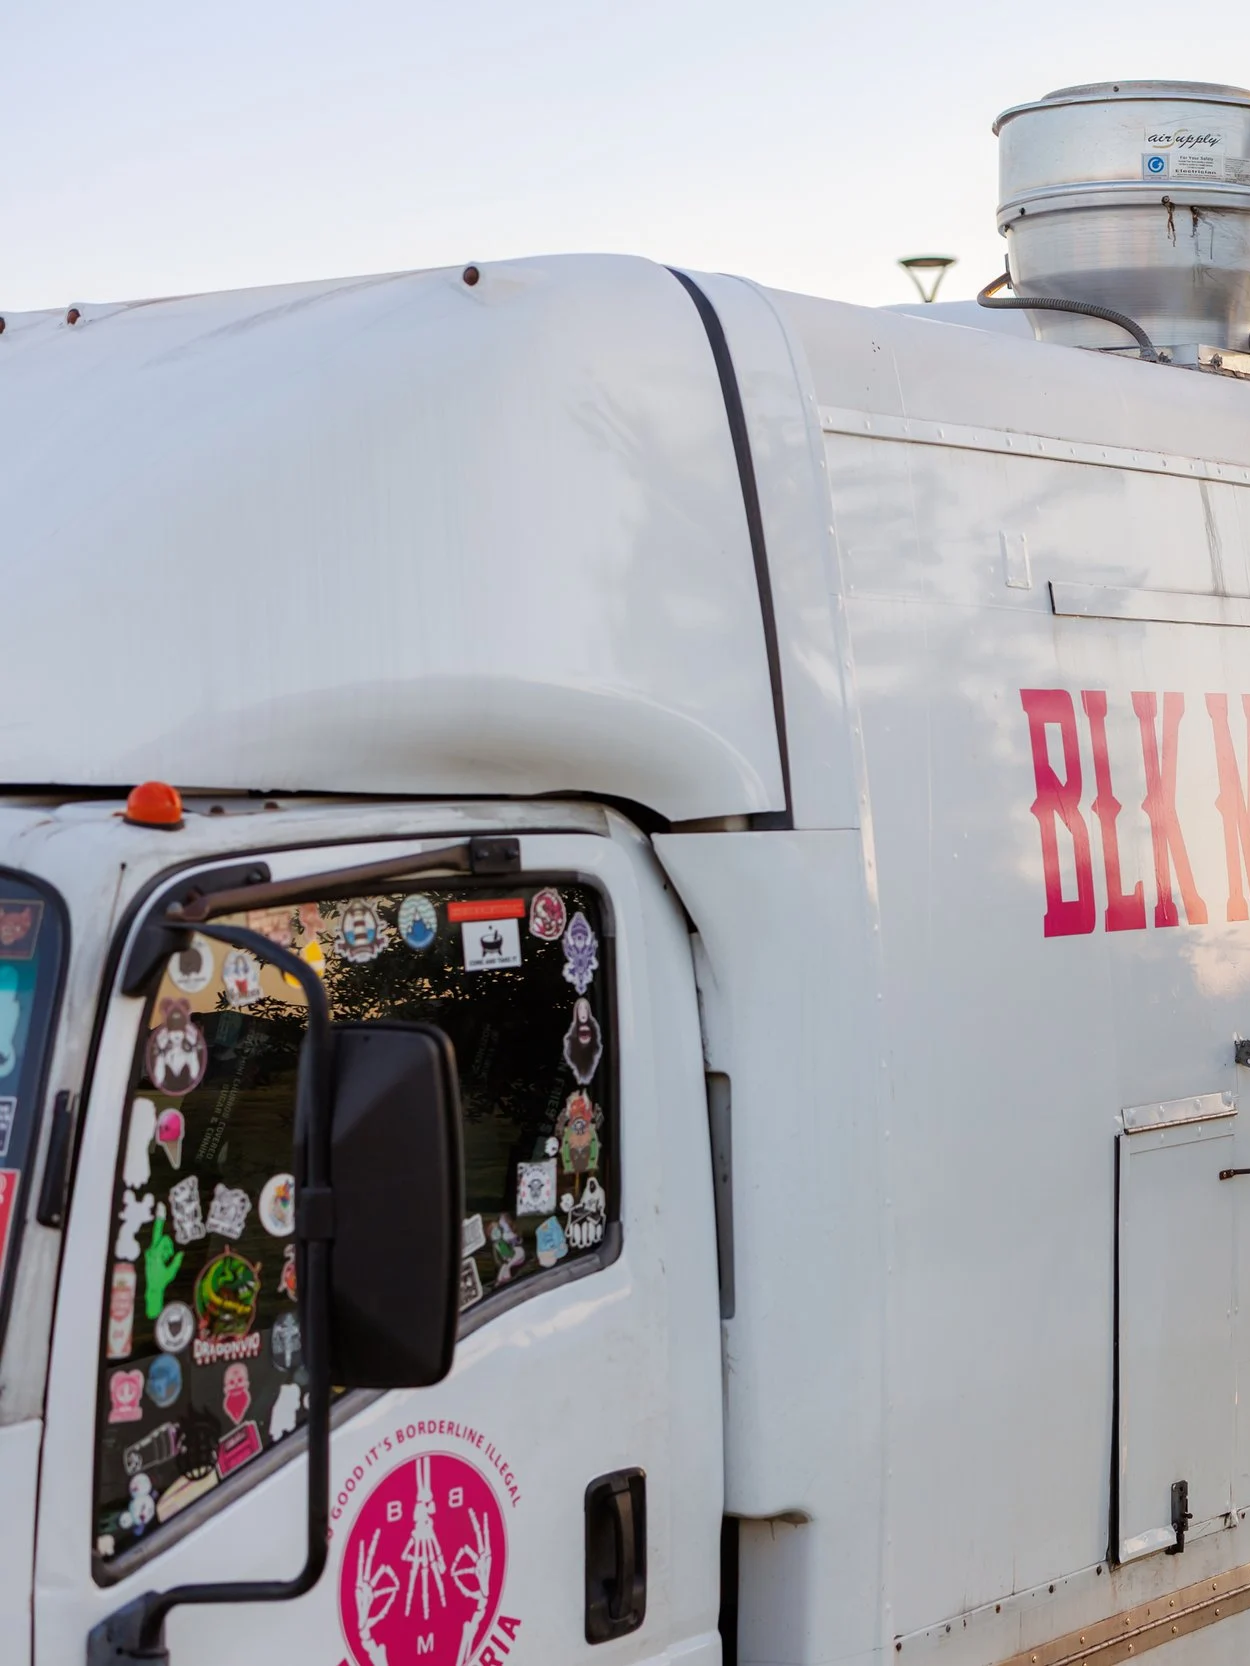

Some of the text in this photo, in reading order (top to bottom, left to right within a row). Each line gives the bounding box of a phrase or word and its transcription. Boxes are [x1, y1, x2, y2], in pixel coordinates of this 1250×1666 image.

[1020, 688, 1208, 938] BLK
[331, 1420, 522, 1520] GOOD IT'S BORDERLINE ILLEGAL
[387, 1500, 402, 1522] B
[417, 1632, 434, 1655] M
